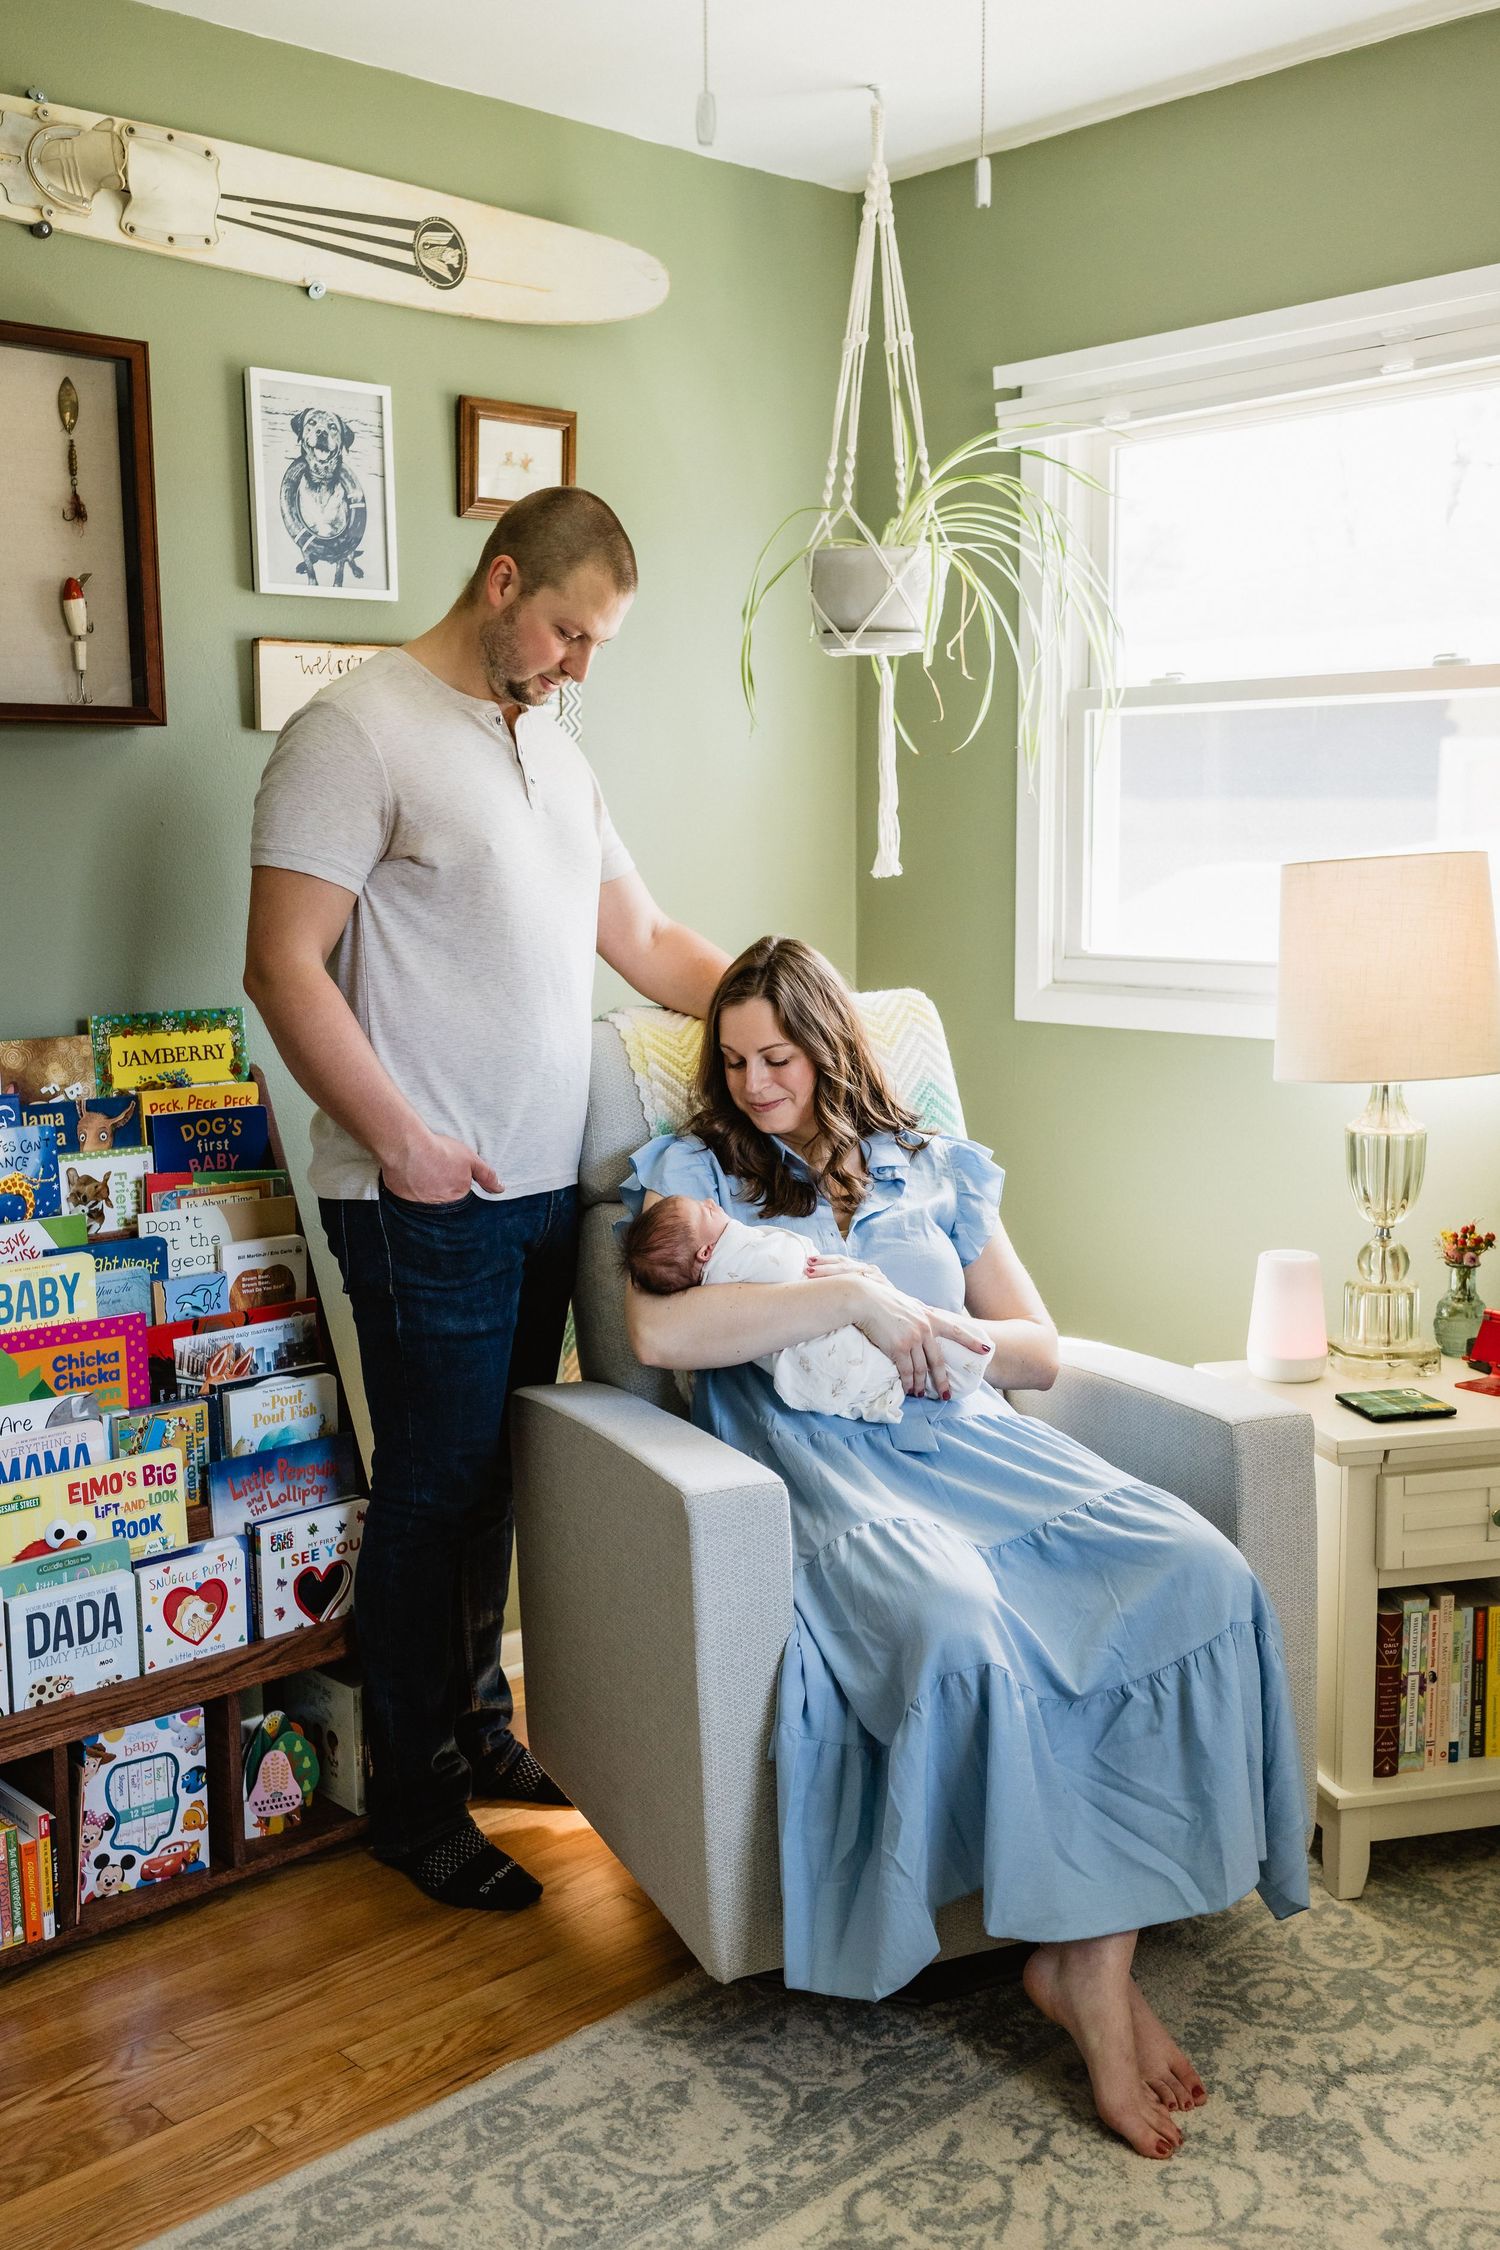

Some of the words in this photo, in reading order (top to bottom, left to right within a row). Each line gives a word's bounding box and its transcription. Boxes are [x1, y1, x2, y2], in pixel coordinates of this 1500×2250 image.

[117, 1043, 226, 1067] JAMBERRY
[22, 1112, 66, 1127] lama
[180, 1117, 243, 1143] DOG'S
[20, 1136, 50, 1154] CAN'T
[197, 1138, 230, 1153] first
[0, 1156, 30, 1171] NCE
[188, 1153, 240, 1173] BABY
[145, 1215, 203, 1234] Don't
[189, 1232, 221, 1248] the
[95, 1256, 119, 1272] ght
[172, 1253, 218, 1273] geon
[0, 1272, 80, 1326] BABY
[52, 1349, 120, 1373] Chicka
[54, 1368, 121, 1391] Chicka
[0, 1416, 33, 1436] Are
[252, 1408, 285, 1428] Pout
[289, 1402, 317, 1420] Fish
[0, 1435, 72, 1458] VERYTHING
[76, 1432, 87, 1442] IS
[186, 1432, 195, 1461] THAT
[0, 1442, 91, 1485] MAMA
[67, 1470, 137, 1506] ELMO'S
[227, 1465, 275, 1501] Little
[20, 1498, 39, 1510] STREET
[246, 1491, 264, 1508] and
[250, 1503, 268, 1517] the
[266, 1484, 328, 1509] Lollipop
[112, 1512, 164, 1541] BOOK
[270, 1540, 294, 1552] CARLE
[320, 1536, 338, 1545] FIRST
[280, 1557, 285, 1569] I
[291, 1548, 320, 1567] SEE
[325, 1537, 361, 1557] YOU
[148, 1569, 199, 1591] SNUGGLE
[202, 1557, 238, 1578] PUPPY!
[24, 1605, 41, 1614] YOUR
[62, 1595, 78, 1604] FIRST
[96, 1587, 111, 1595] WILL
[26, 1592, 123, 1659] DADA
[1412, 1635, 1418, 1645] TO
[28, 1650, 70, 1675] JIMMY
[75, 1636, 124, 1659] FALLON
[99, 1658, 114, 1667] MOO
[174, 1651, 192, 1661] little
[194, 1648, 209, 1656] love
[210, 1643, 226, 1651] song
[124, 1740, 159, 1757] baby
[128, 1809, 140, 1819] 12
[27, 1861, 36, 1899] GOODNIGHT
[479, 1859, 518, 1894] OMBAS
[0, 1862, 12, 1930] OPPOSITES
